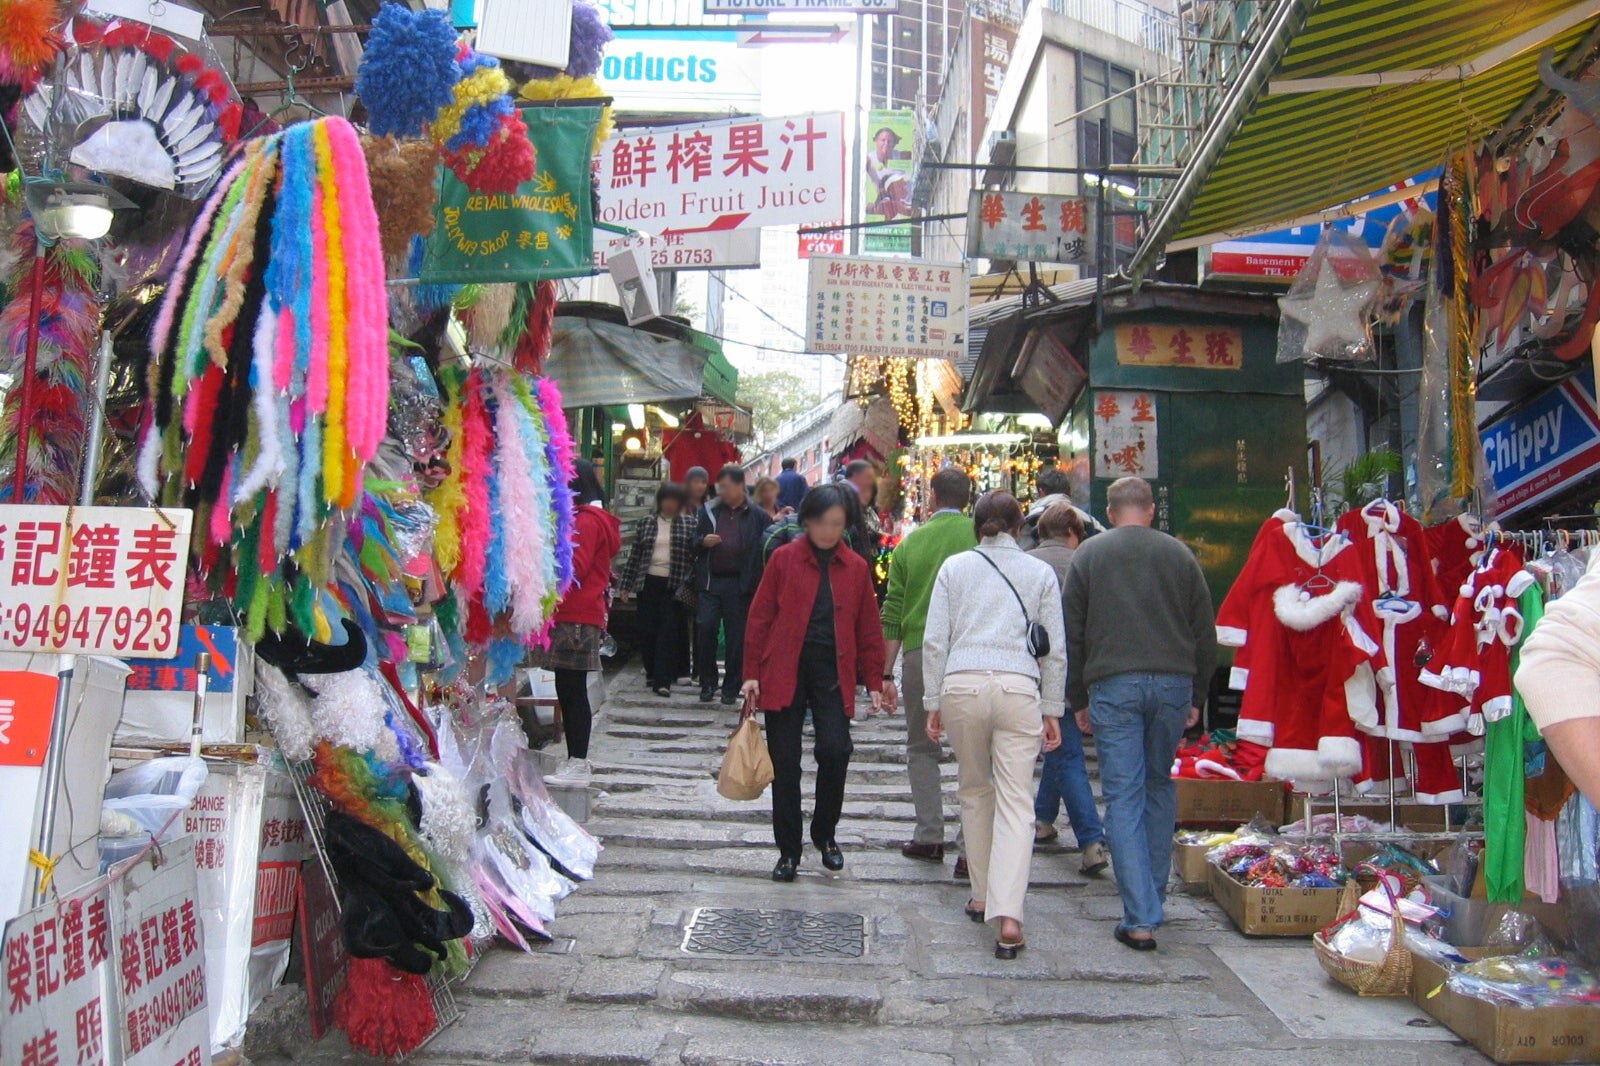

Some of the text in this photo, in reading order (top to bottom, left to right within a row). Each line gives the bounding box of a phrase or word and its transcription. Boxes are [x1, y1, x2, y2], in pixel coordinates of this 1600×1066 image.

[610, 117, 828, 190] 鮮榨果汁
[464, 194, 508, 212] RETAIL
[598, 184, 827, 223] olden Fruit Juice
[674, 249, 713, 264] 8753
[807, 240, 835, 254] city
[1246, 256, 1295, 266] Basement
[1263, 267, 1284, 276] TEL
[901, 283, 933, 292] ELECTRICAL
[1482, 403, 1563, 478] Chippy
[0, 521, 177, 591] 記鐘表
[0, 602, 173, 652] :94947923
[185, 817, 227, 833] BATTERY
[194, 838, 225, 869] 換電池
[256, 867, 298, 917] REPAIR
[1262, 887, 1284, 896] TOTAL
[6, 895, 108, 1016] 榮記鐘表
[120, 898, 199, 998] 榮記鐘表
